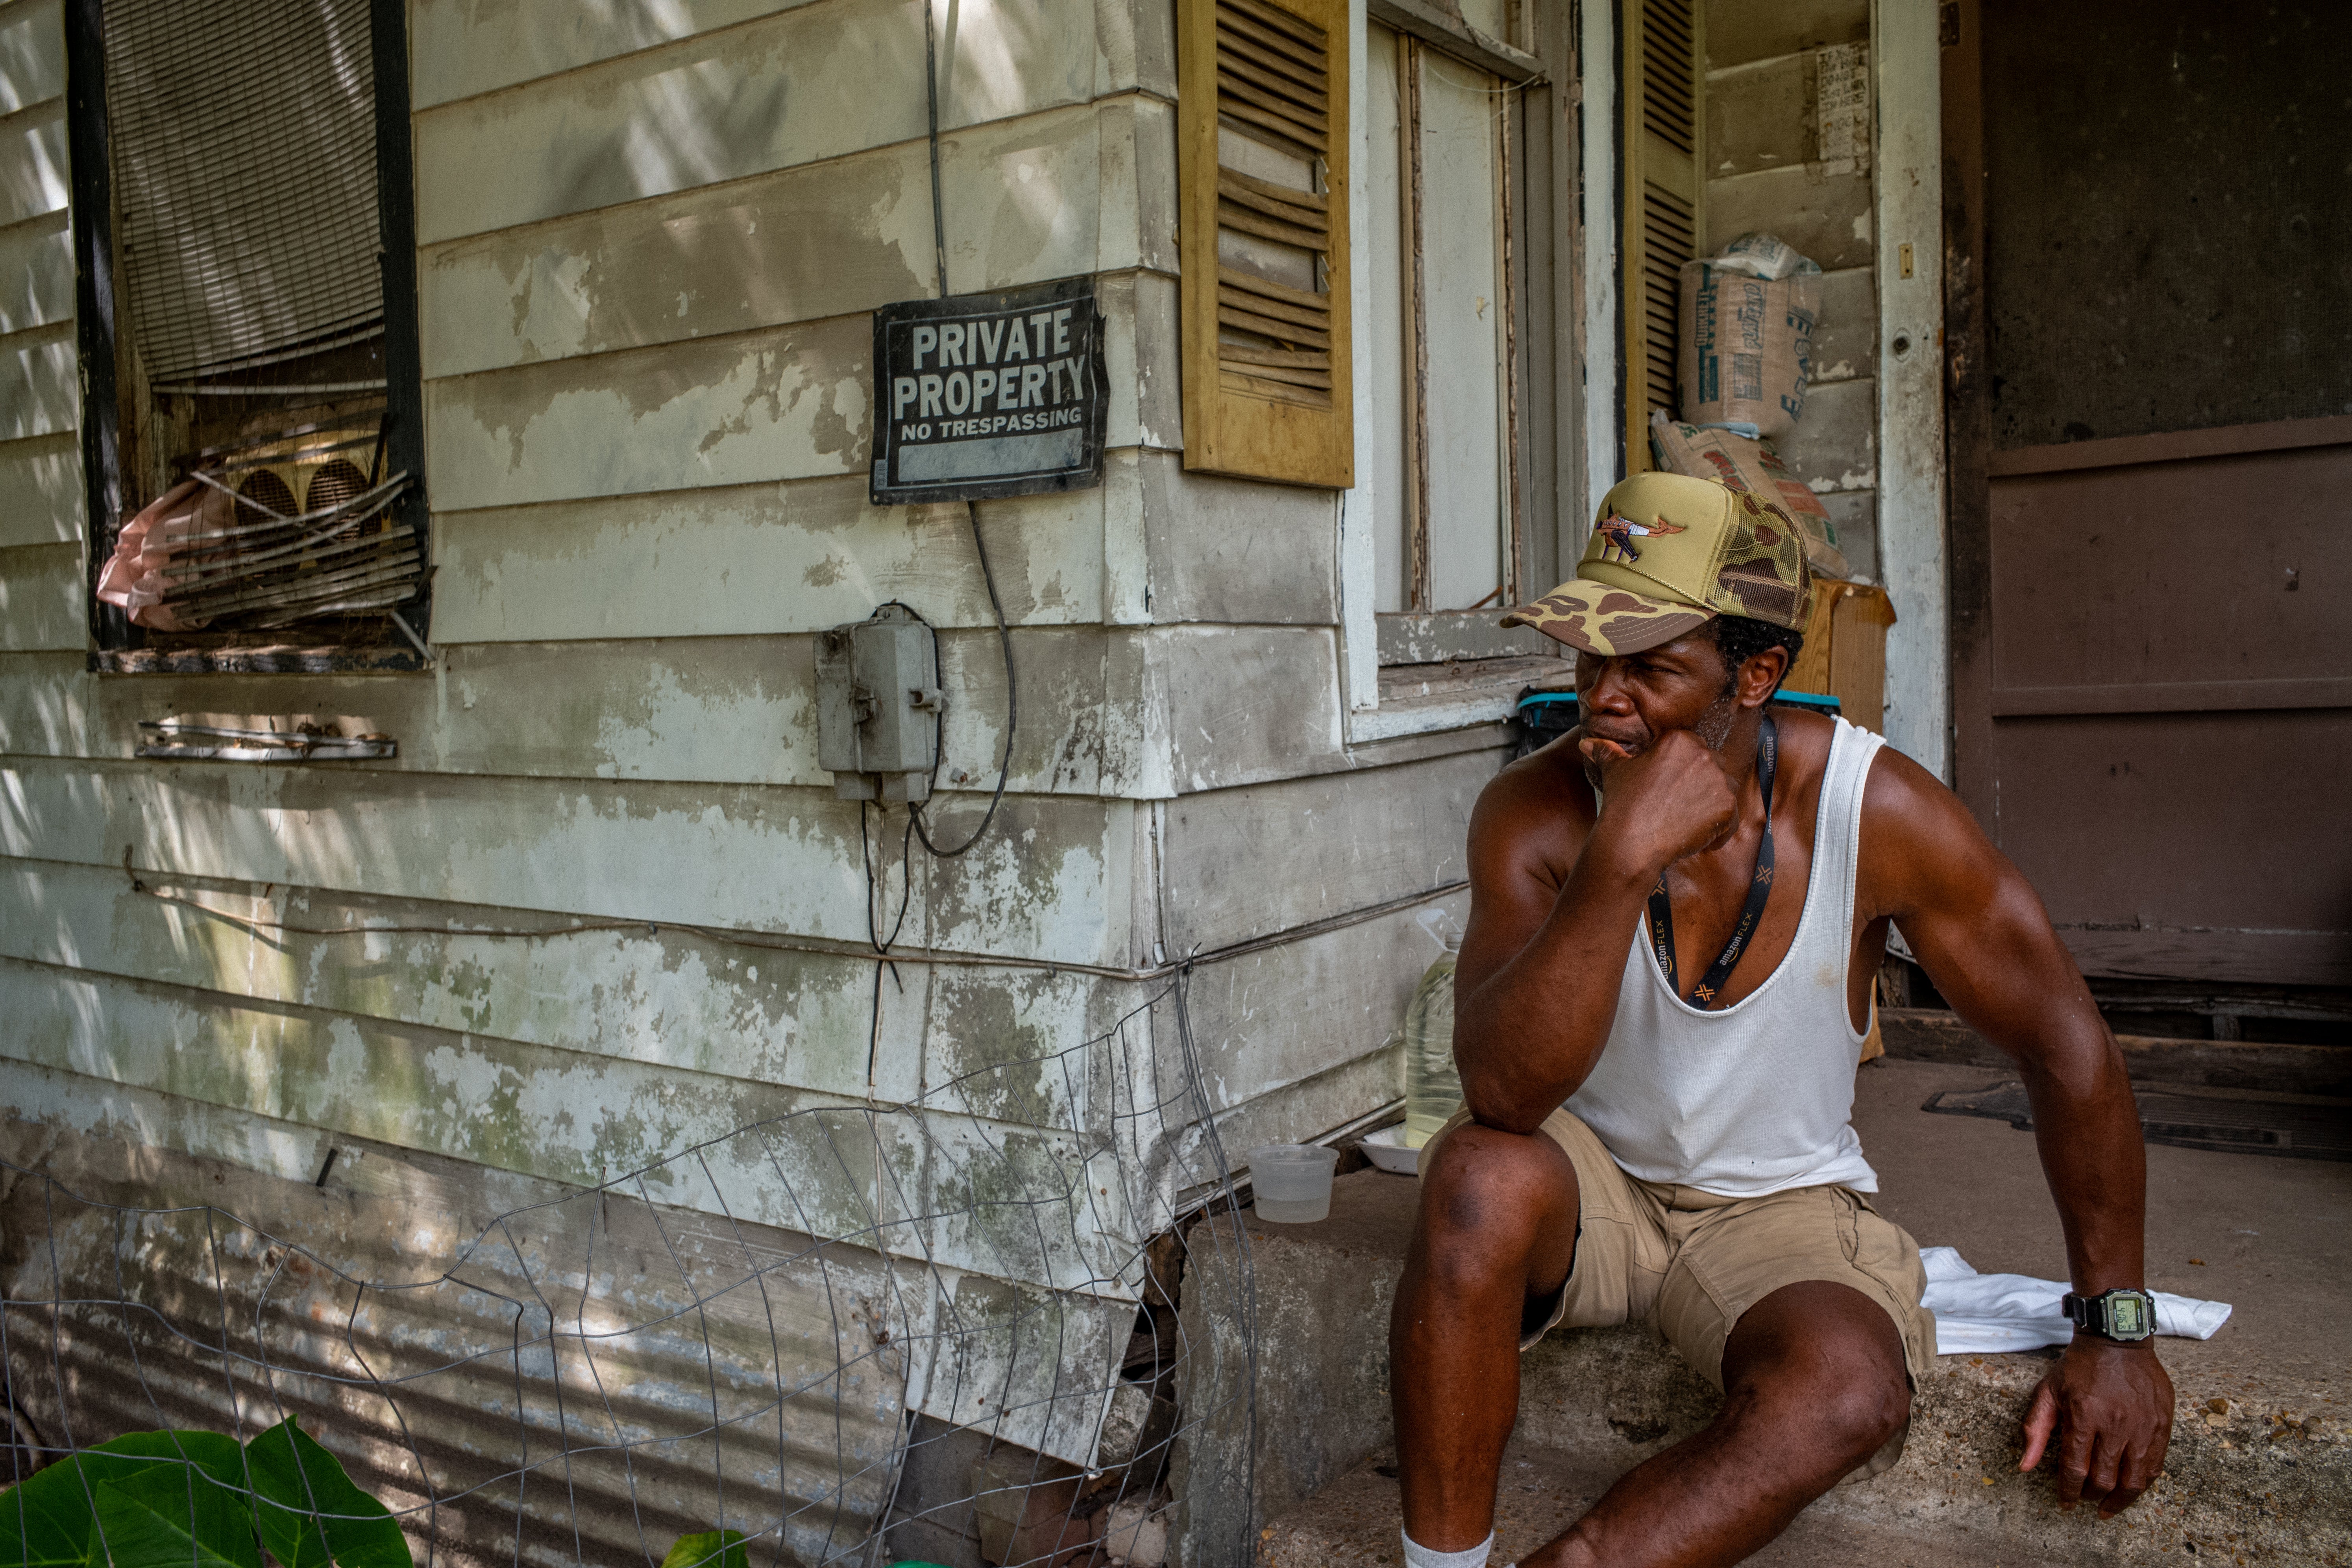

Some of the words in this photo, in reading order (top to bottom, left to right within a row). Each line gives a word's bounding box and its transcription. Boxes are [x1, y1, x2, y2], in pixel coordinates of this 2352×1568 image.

[913, 308, 1072, 370] PRIVATE
[894, 354, 1085, 420] PROPERTY
[901, 423, 932, 441] NO
[939, 406, 1082, 438] TRESPASSING
[1656, 920, 1665, 944] FLEX
[1720, 936, 1742, 965] amazon
[1738, 913, 1753, 936] FLEX
